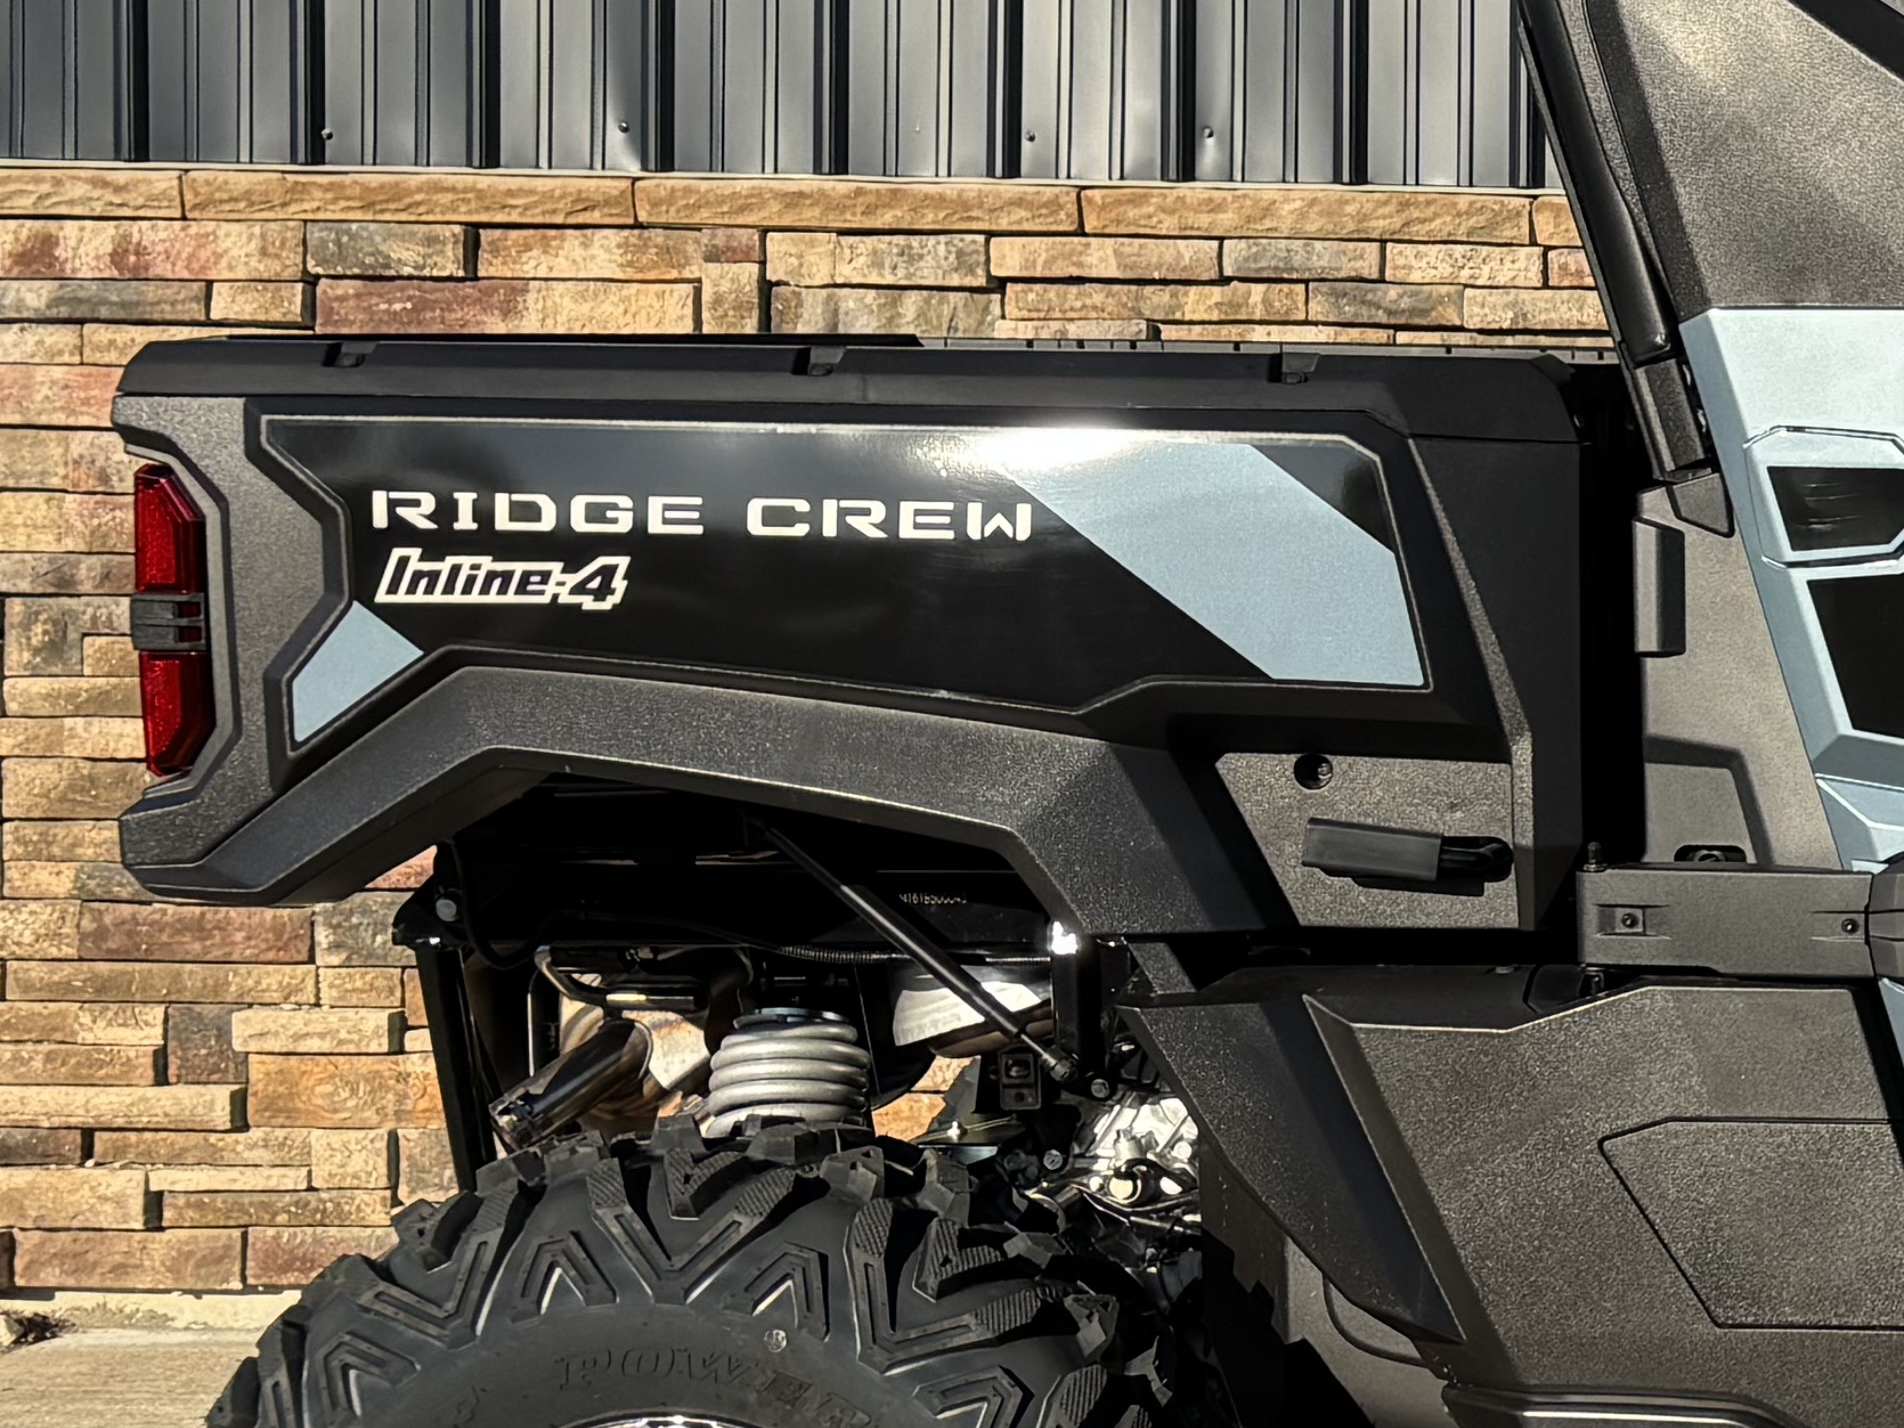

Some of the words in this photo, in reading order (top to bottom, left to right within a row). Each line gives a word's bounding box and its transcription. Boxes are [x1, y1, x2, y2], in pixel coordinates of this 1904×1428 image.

[372, 490, 704, 535] RIDGE
[747, 498, 1032, 541] CREW
[374, 548, 631, 610] Inline-4
